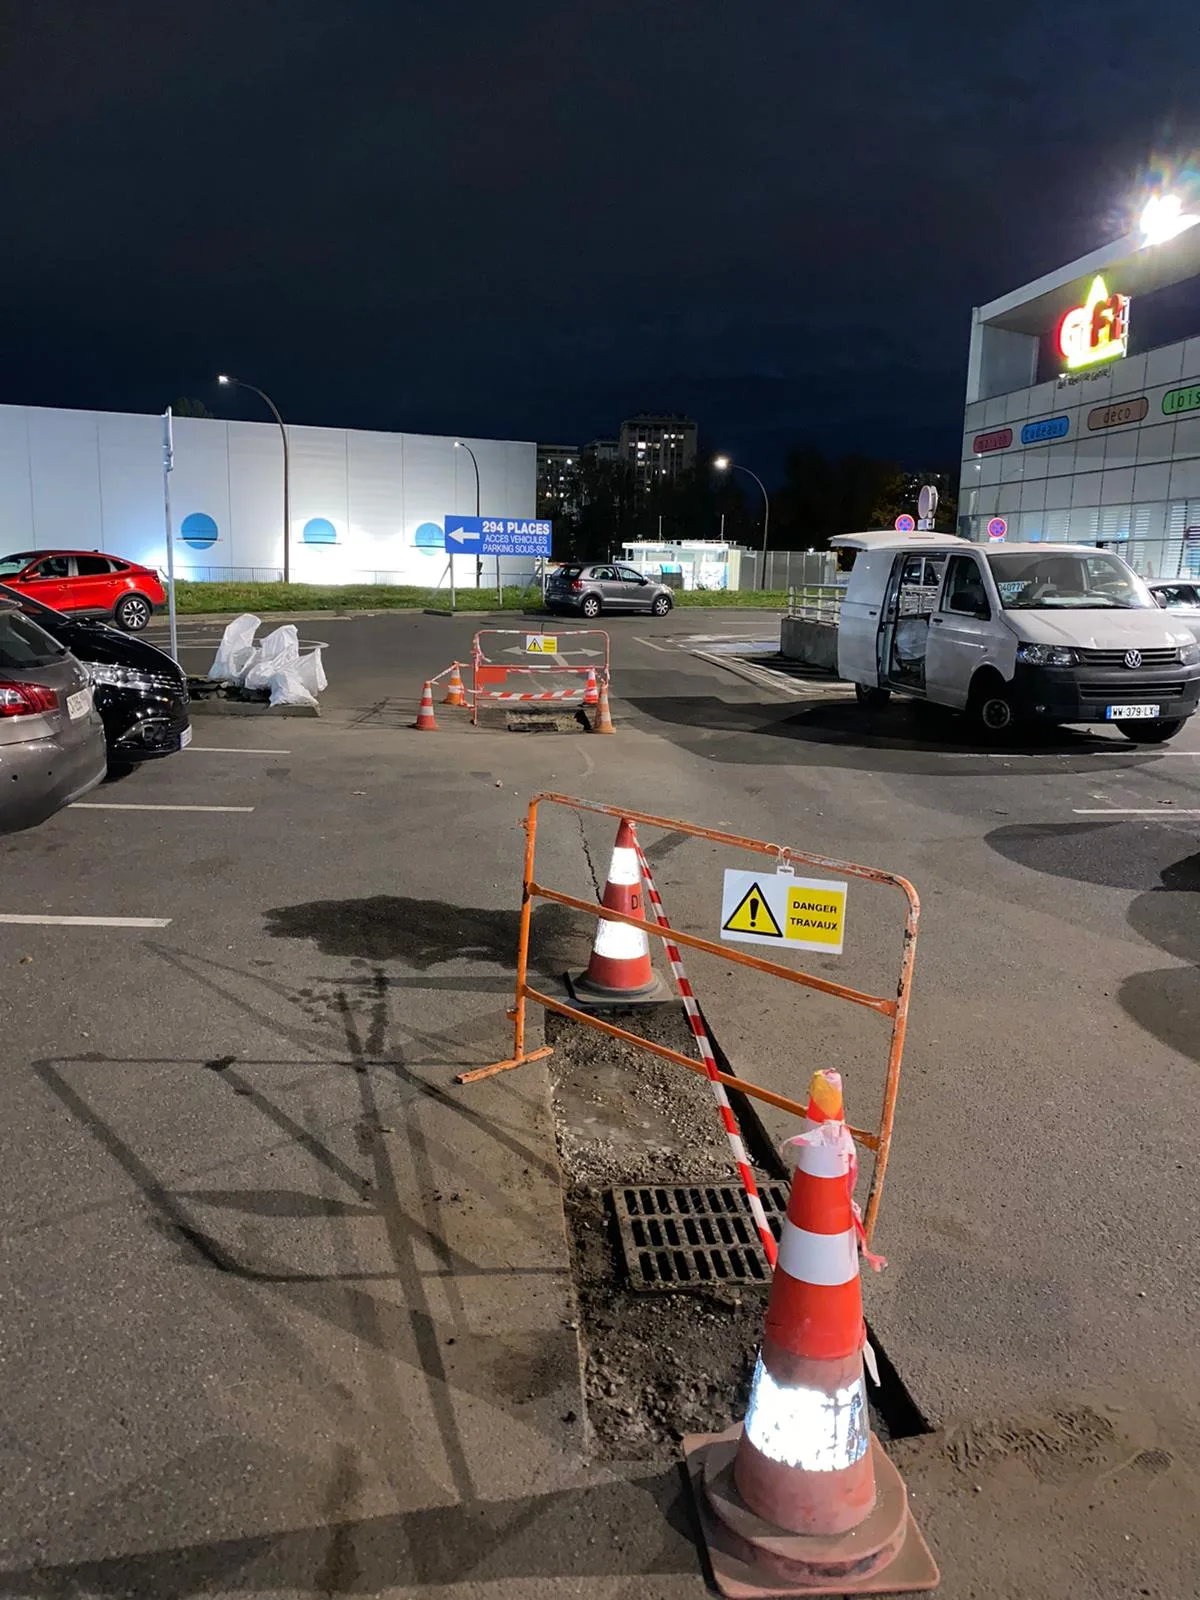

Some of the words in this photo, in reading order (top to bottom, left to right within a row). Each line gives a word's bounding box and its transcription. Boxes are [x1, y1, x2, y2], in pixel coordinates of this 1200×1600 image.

[482, 520, 504, 533] 294
[508, 521, 550, 535] PLACES
[485, 534, 509, 543] ACCES
[510, 535, 547, 544] VEHICULES
[483, 544, 513, 553] PARKING
[515, 545, 550, 554] SOUS-SOL
[793, 901, 837, 914] DANGER
[790, 917, 838, 931] TRAVAUX
